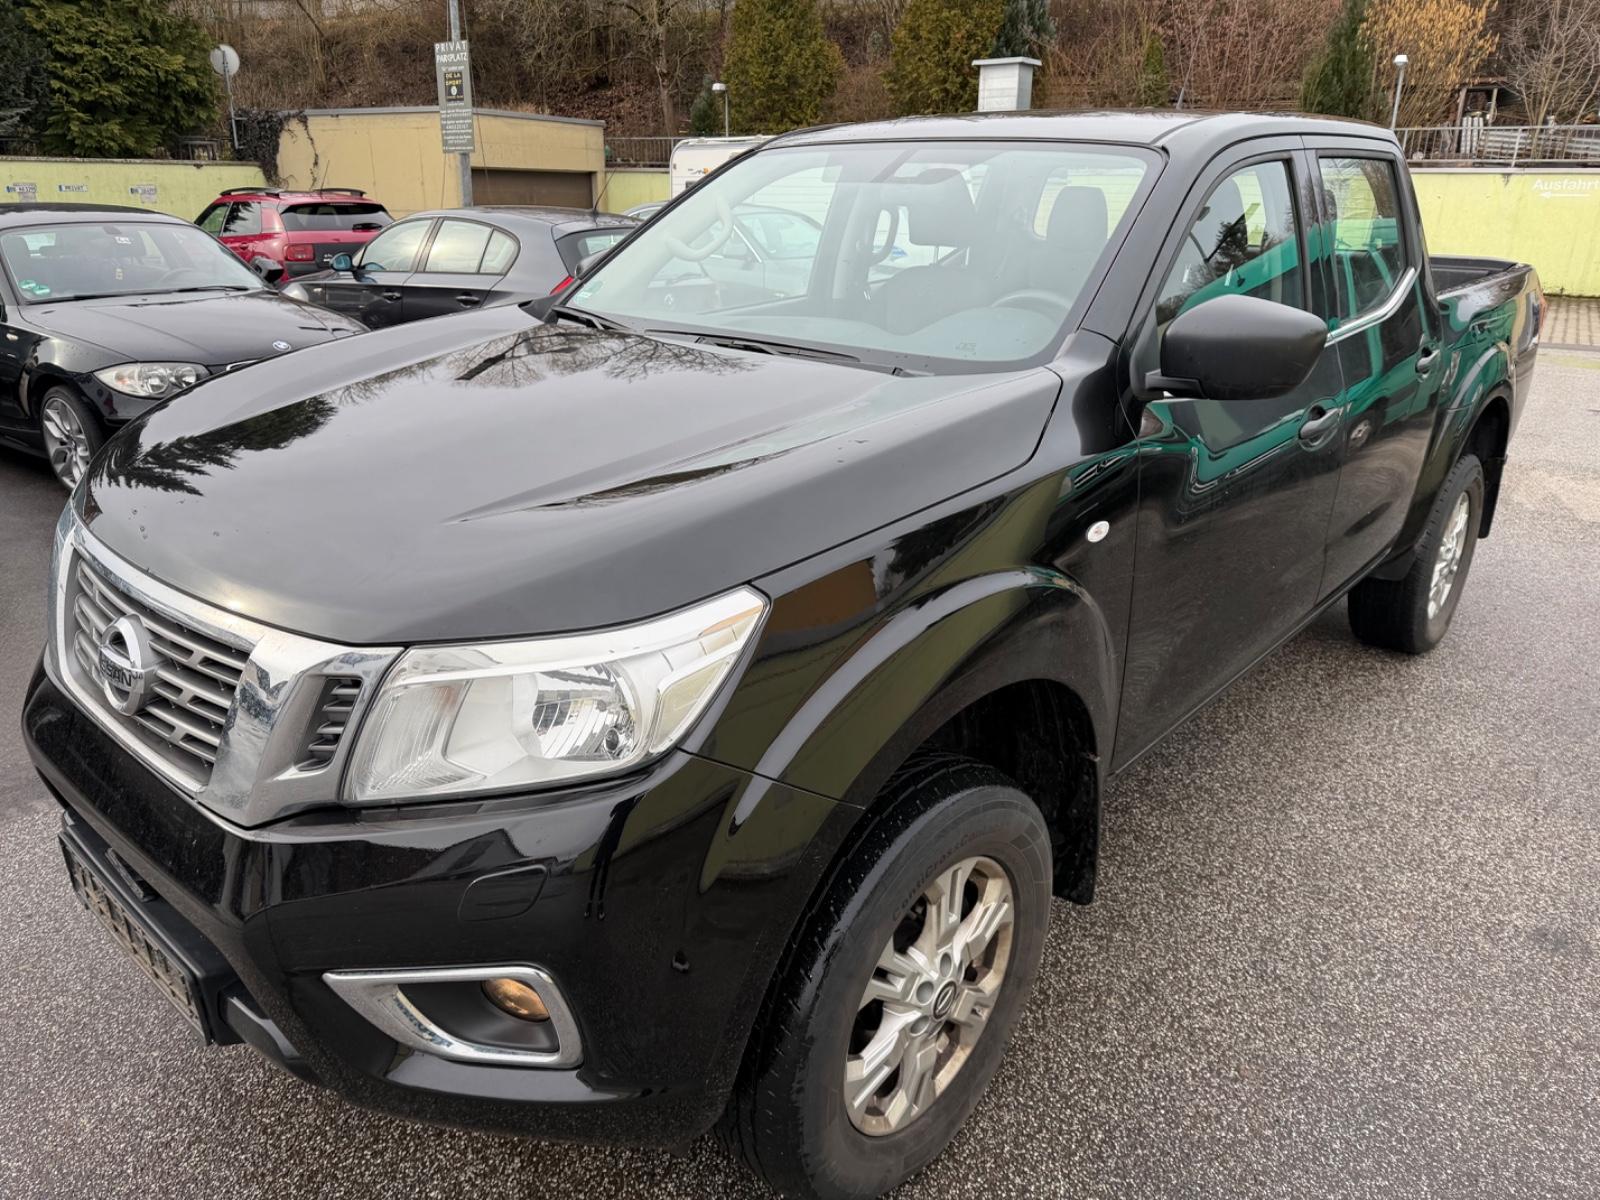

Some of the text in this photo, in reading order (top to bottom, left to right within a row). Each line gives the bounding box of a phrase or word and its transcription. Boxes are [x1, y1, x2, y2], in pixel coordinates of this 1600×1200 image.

[435, 41, 467, 52] PRIVAT
[436, 52, 468, 63] PARKPLATZ
[1531, 178, 1600, 191] Ausfahrt
